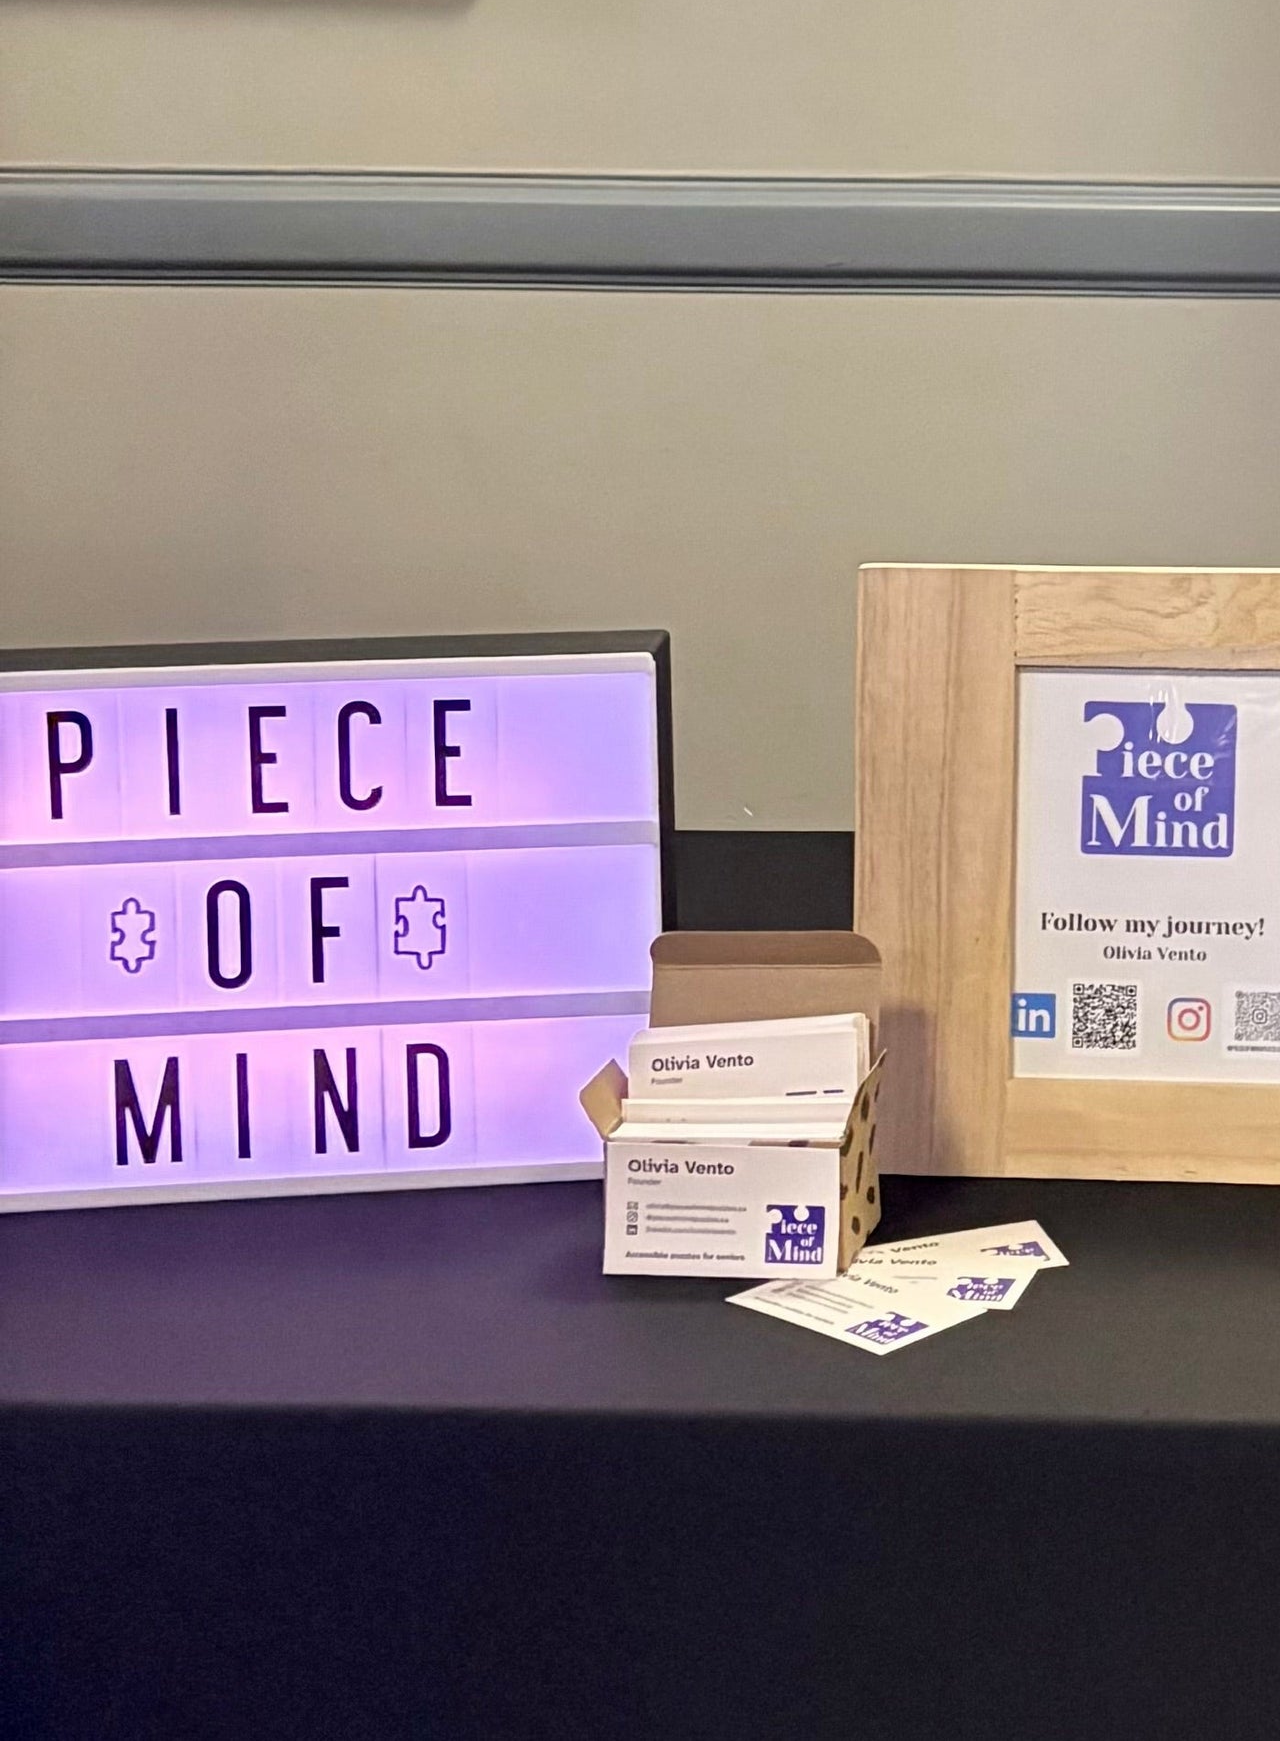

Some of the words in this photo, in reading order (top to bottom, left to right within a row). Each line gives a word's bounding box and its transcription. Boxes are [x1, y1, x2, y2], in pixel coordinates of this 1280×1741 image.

[46, 699, 473, 820] PIECE
[1083, 712, 1216, 780] Piece
[1173, 785, 1210, 813] of
[1087, 793, 1229, 850] Mind
[206, 876, 349, 990] OF
[1041, 913, 1118, 934] Follow
[1125, 920, 1161, 942] my
[1163, 918, 1266, 943] journey!
[1102, 945, 1153, 962] Olivia
[1157, 947, 1208, 963] Vento
[651, 1056, 700, 1073] Olivia
[706, 1054, 754, 1069] Vento
[113, 1043, 452, 1167] MIND
[627, 1157, 679, 1175] Olivia
[684, 1159, 735, 1176] Vento
[768, 1240, 822, 1262] Mind
